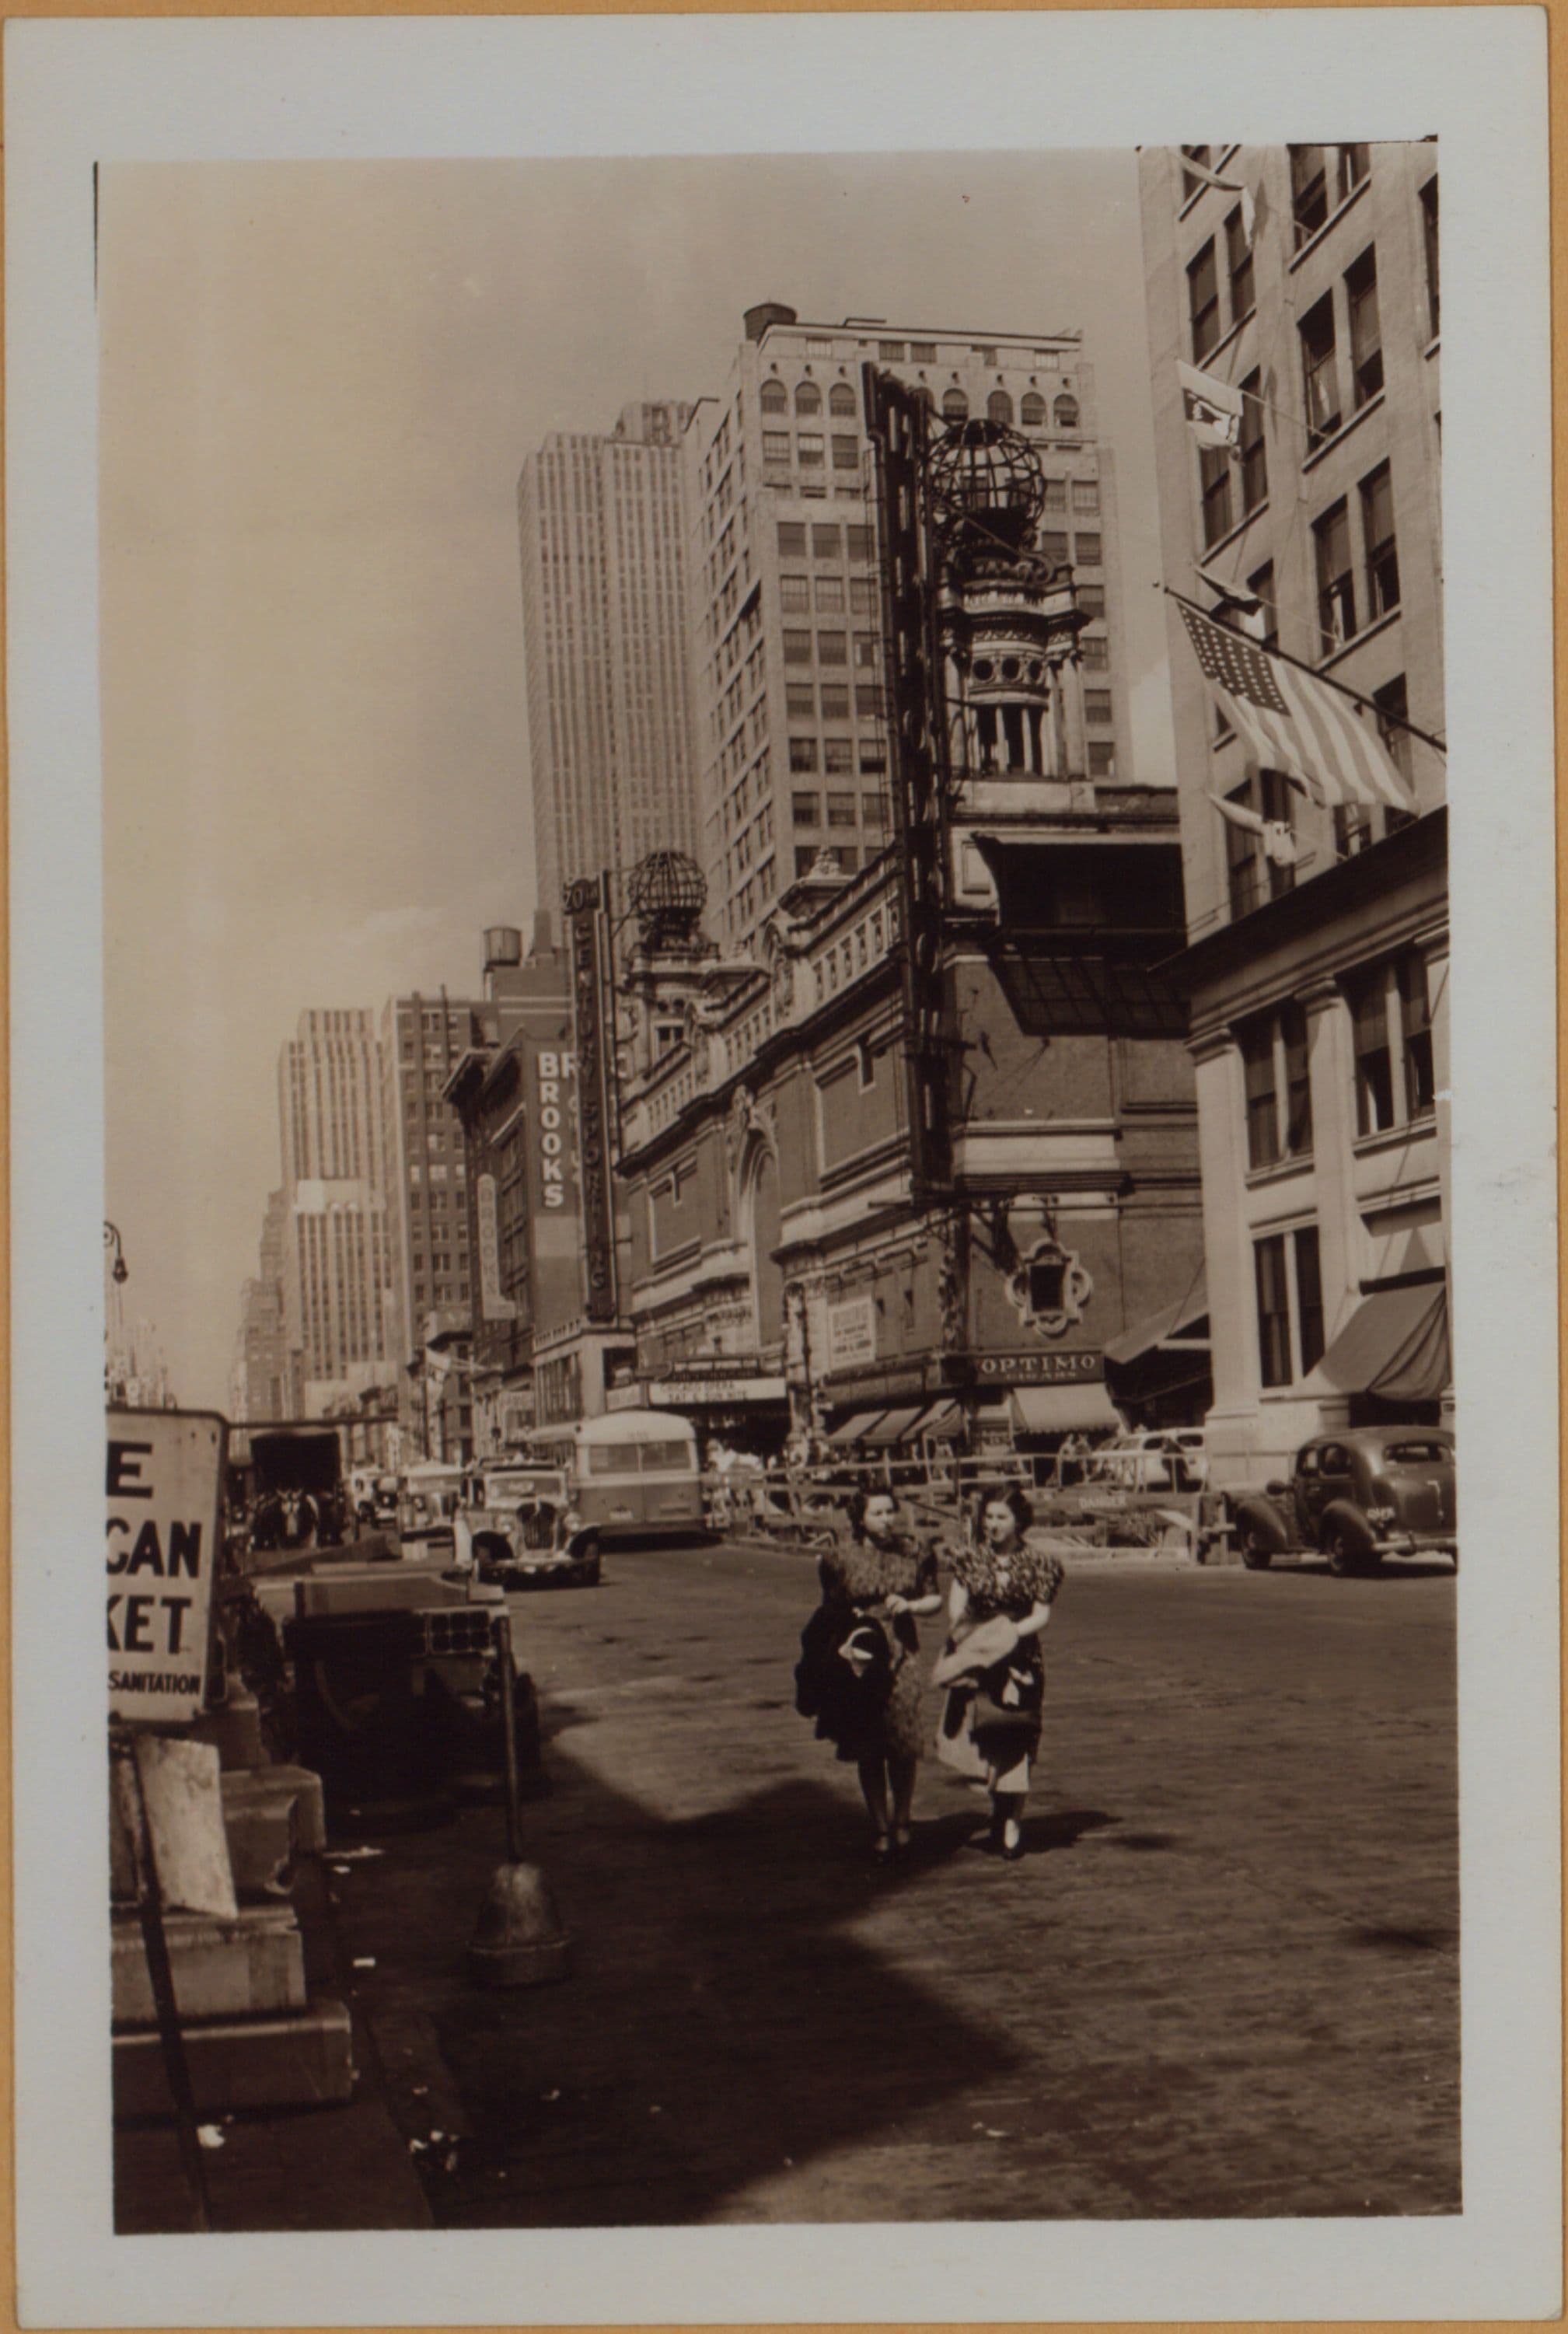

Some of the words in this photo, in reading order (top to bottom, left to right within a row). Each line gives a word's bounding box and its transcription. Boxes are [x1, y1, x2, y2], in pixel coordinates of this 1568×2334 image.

[537, 1051, 564, 1208] BROOKS
[981, 1354, 1095, 1374] OPTIMO
[108, 1669, 201, 1696] SANITATION
